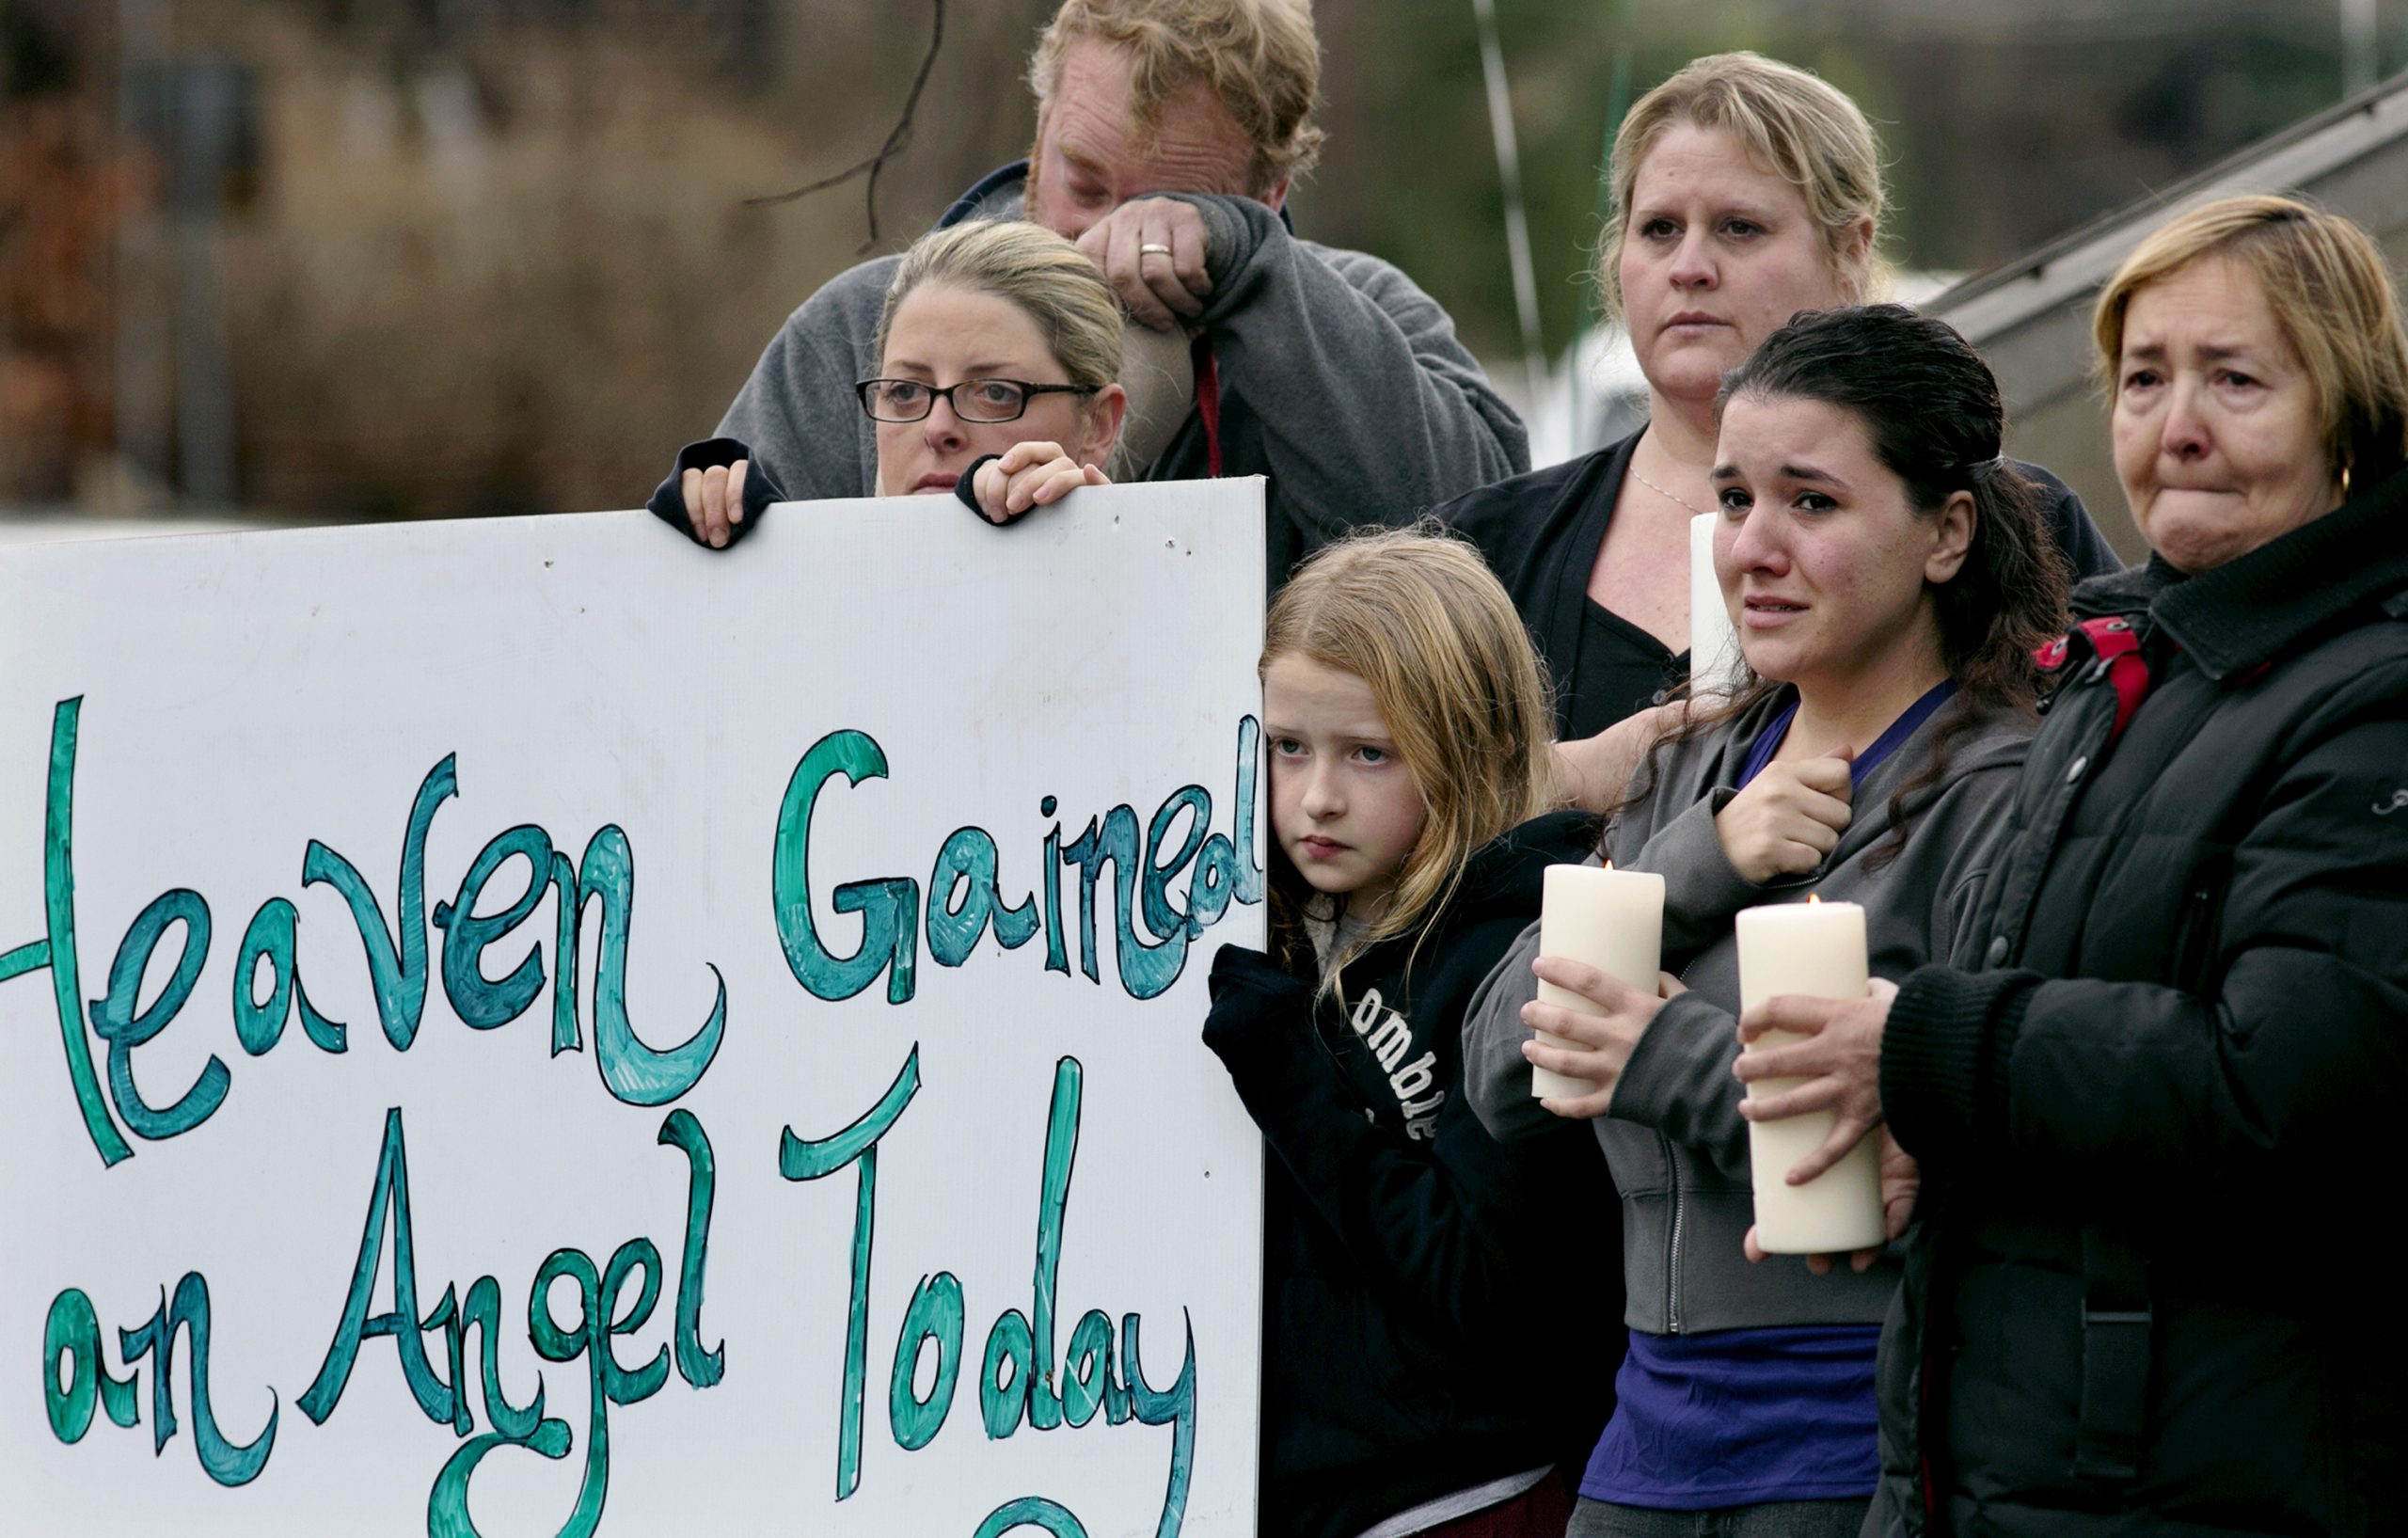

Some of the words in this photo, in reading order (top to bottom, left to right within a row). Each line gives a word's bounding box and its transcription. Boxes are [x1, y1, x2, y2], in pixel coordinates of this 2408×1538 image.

[772, 714, 1262, 1005] Gained
[43, 1270, 278, 1487] an
[294, 1106, 724, 1538] Angel
[779, 1040, 1196, 1538] Today
